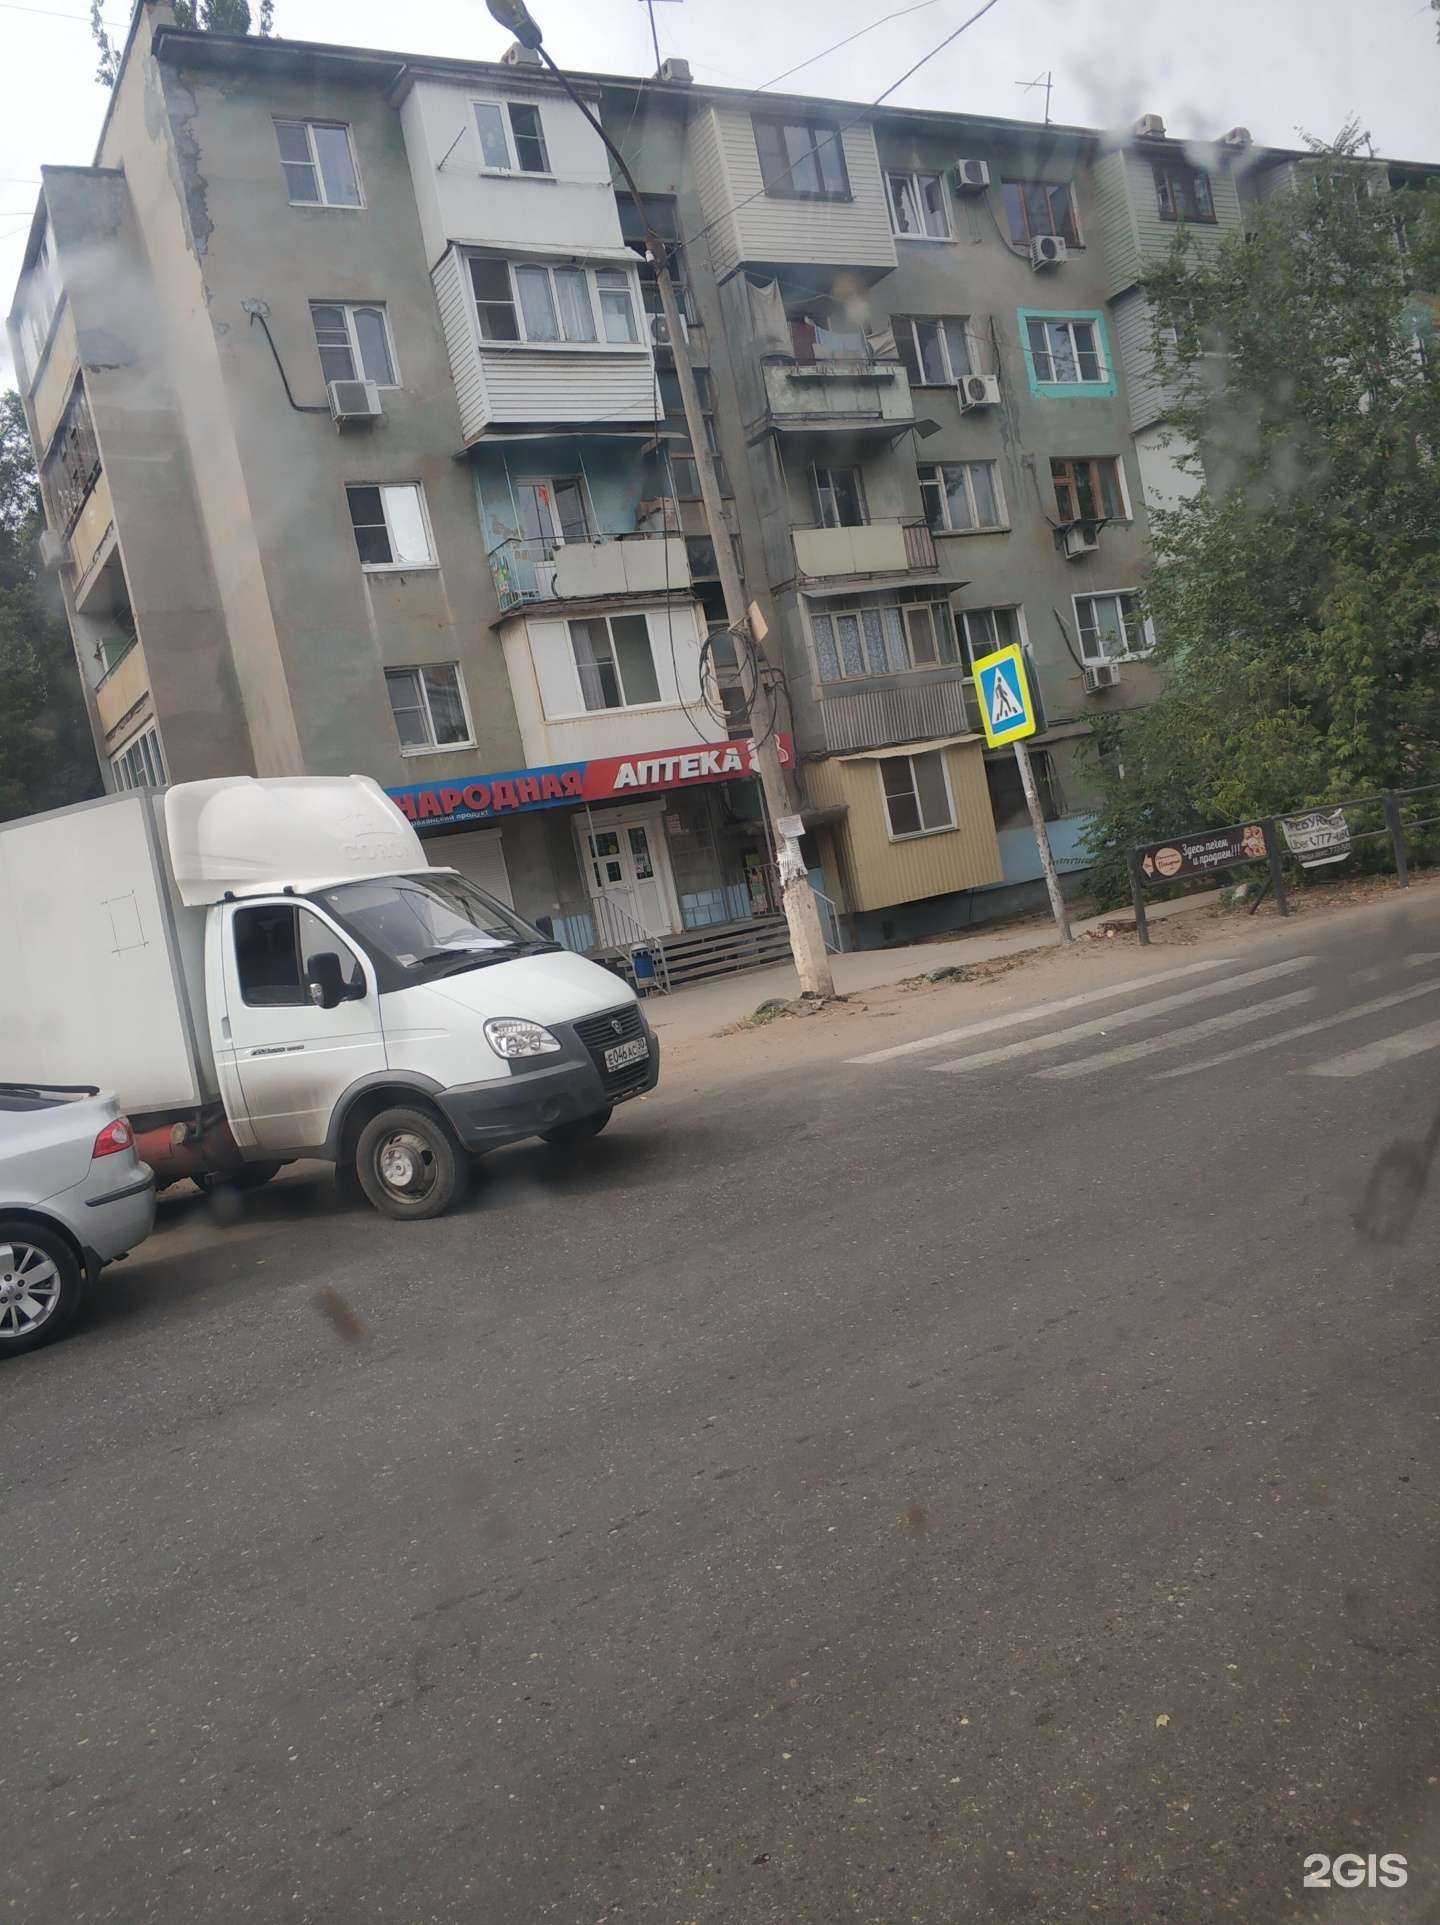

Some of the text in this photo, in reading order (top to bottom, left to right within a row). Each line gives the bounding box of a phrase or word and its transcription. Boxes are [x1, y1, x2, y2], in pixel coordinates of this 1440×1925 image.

[391, 747, 743, 819] НАРОДНАЯ АПТЕКА
[1182, 843, 1205, 859] Здесь
[1192, 856, 1199, 866] и
